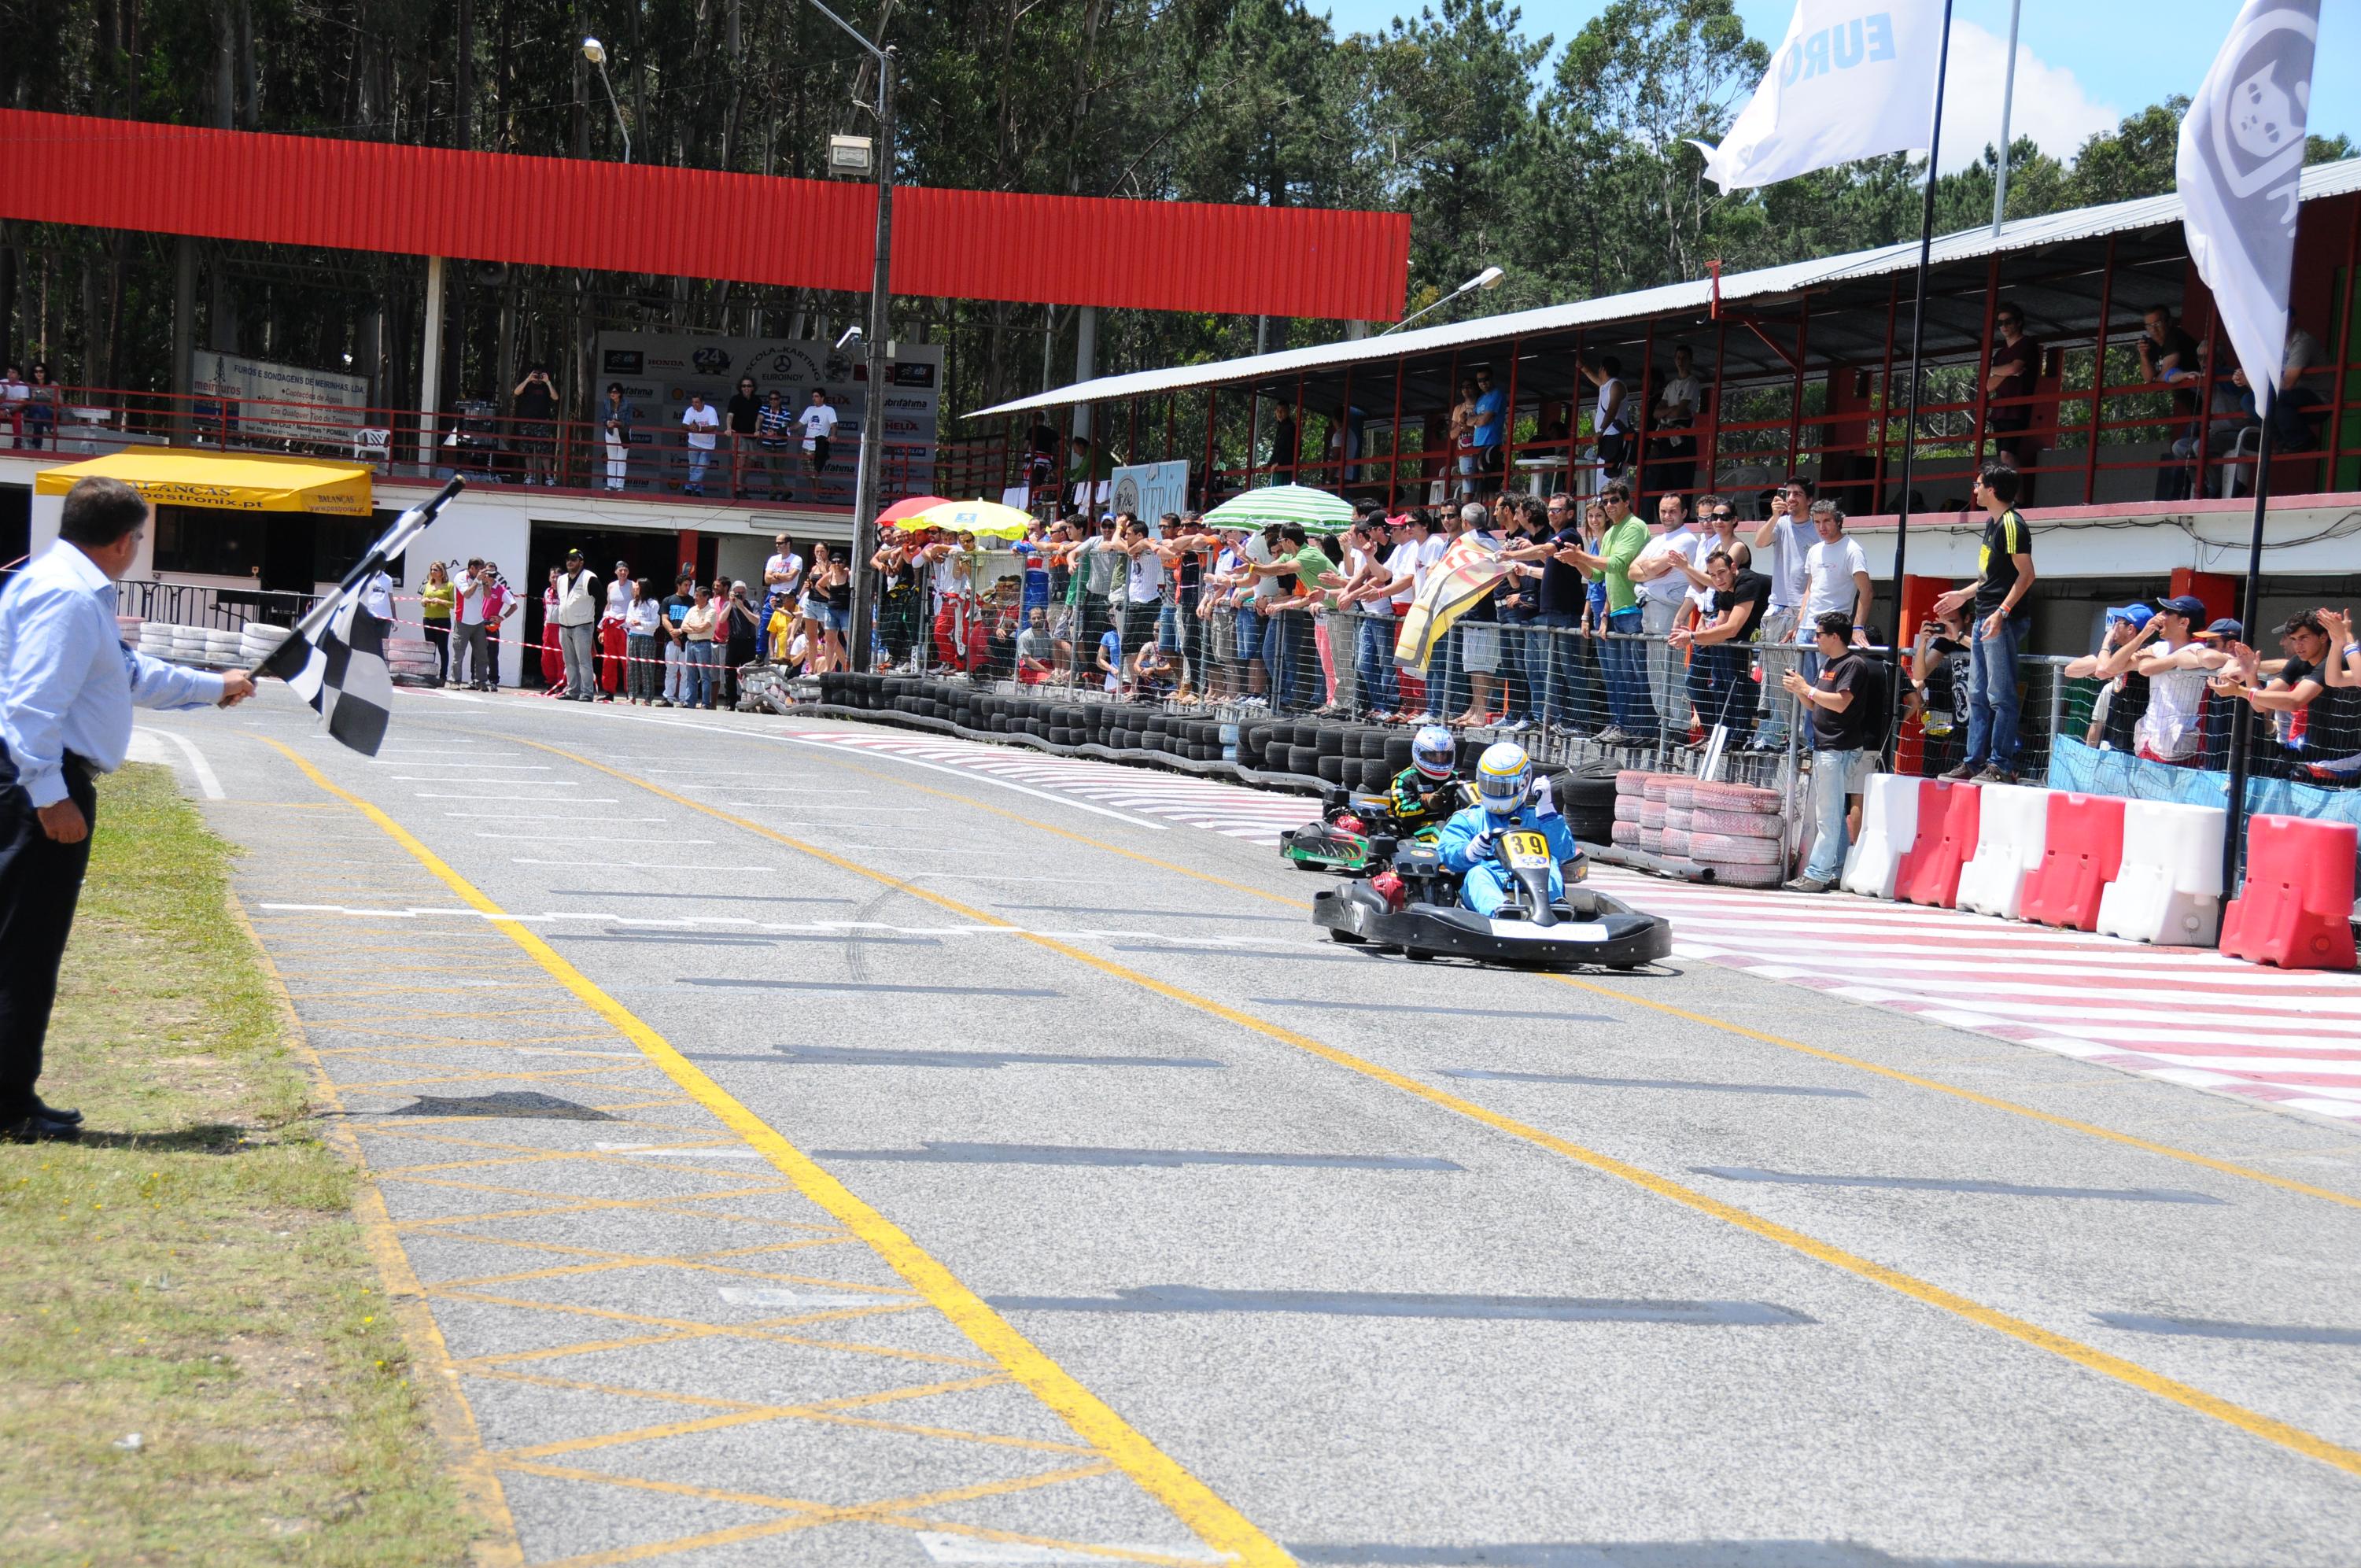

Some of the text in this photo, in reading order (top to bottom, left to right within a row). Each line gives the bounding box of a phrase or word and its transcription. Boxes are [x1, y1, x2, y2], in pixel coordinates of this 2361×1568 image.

[698, 349, 721, 363] 24
[783, 346, 821, 381] KARTING
[234, 365, 257, 377] FUROS
[264, 371, 304, 385] SONDAGENS
[305, 378, 314, 386] DE
[282, 408, 309, 419] Qualquer
[310, 413, 323, 424] Tipo
[297, 423, 323, 434] Meirinhas
[326, 429, 349, 437] POMBAL
[885, 421, 919, 430] HELIX
[130, 481, 231, 496] ALANÇAS
[139, 492, 264, 509] pestronix.pt
[318, 494, 354, 504] BALANÇAS
[1510, 835, 1544, 855] 39
